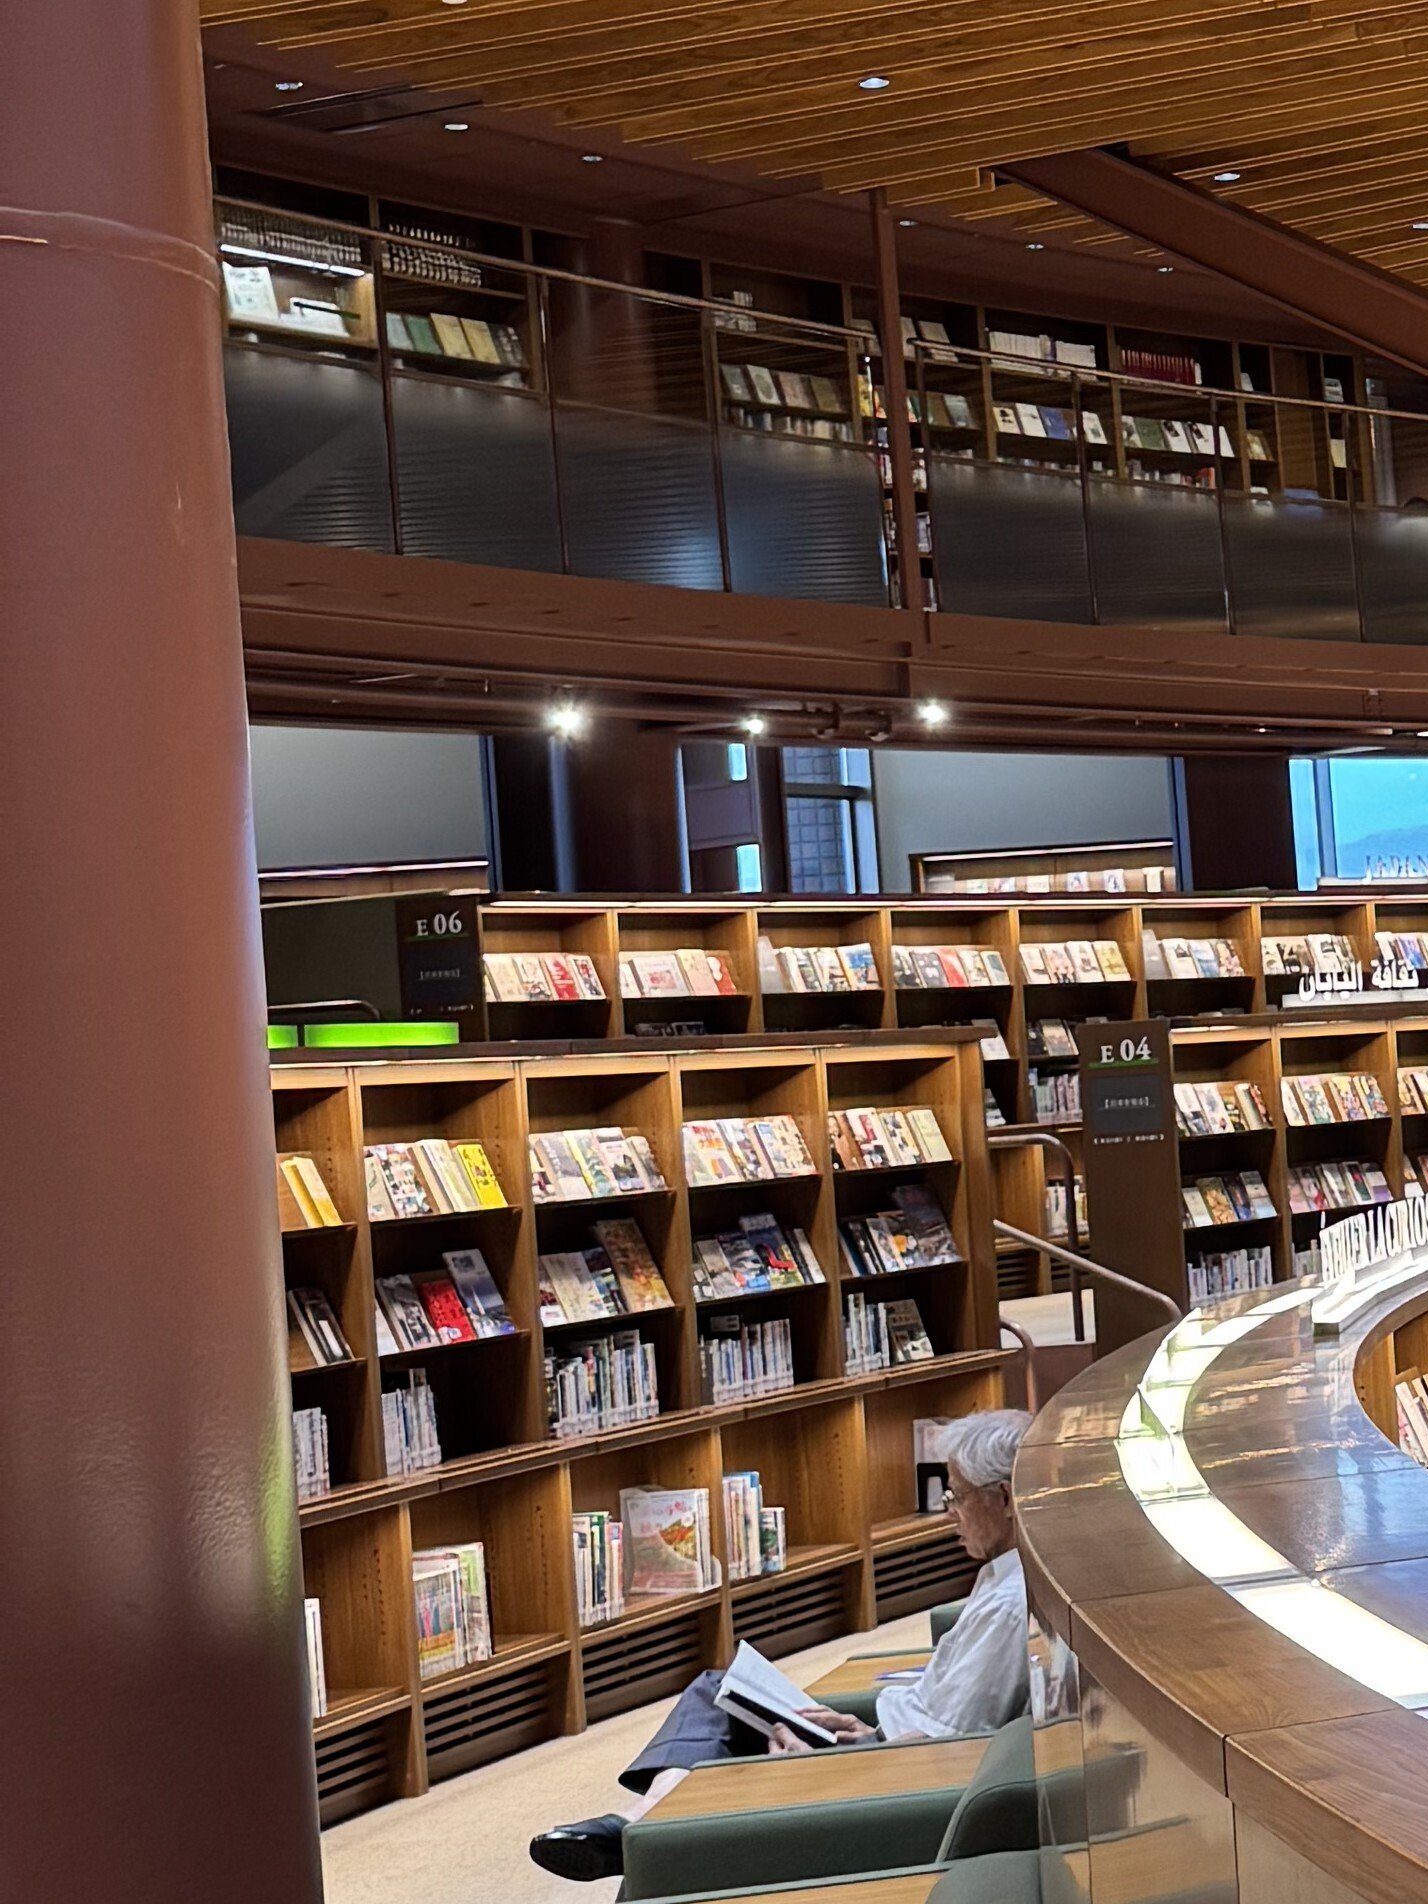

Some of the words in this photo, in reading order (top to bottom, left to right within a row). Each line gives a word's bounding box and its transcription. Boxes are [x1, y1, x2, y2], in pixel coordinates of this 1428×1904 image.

[416, 919, 429, 936] E
[433, 911, 462, 934] 06
[1101, 1045, 1114, 1063] E
[1120, 1036, 1152, 1061] 04
